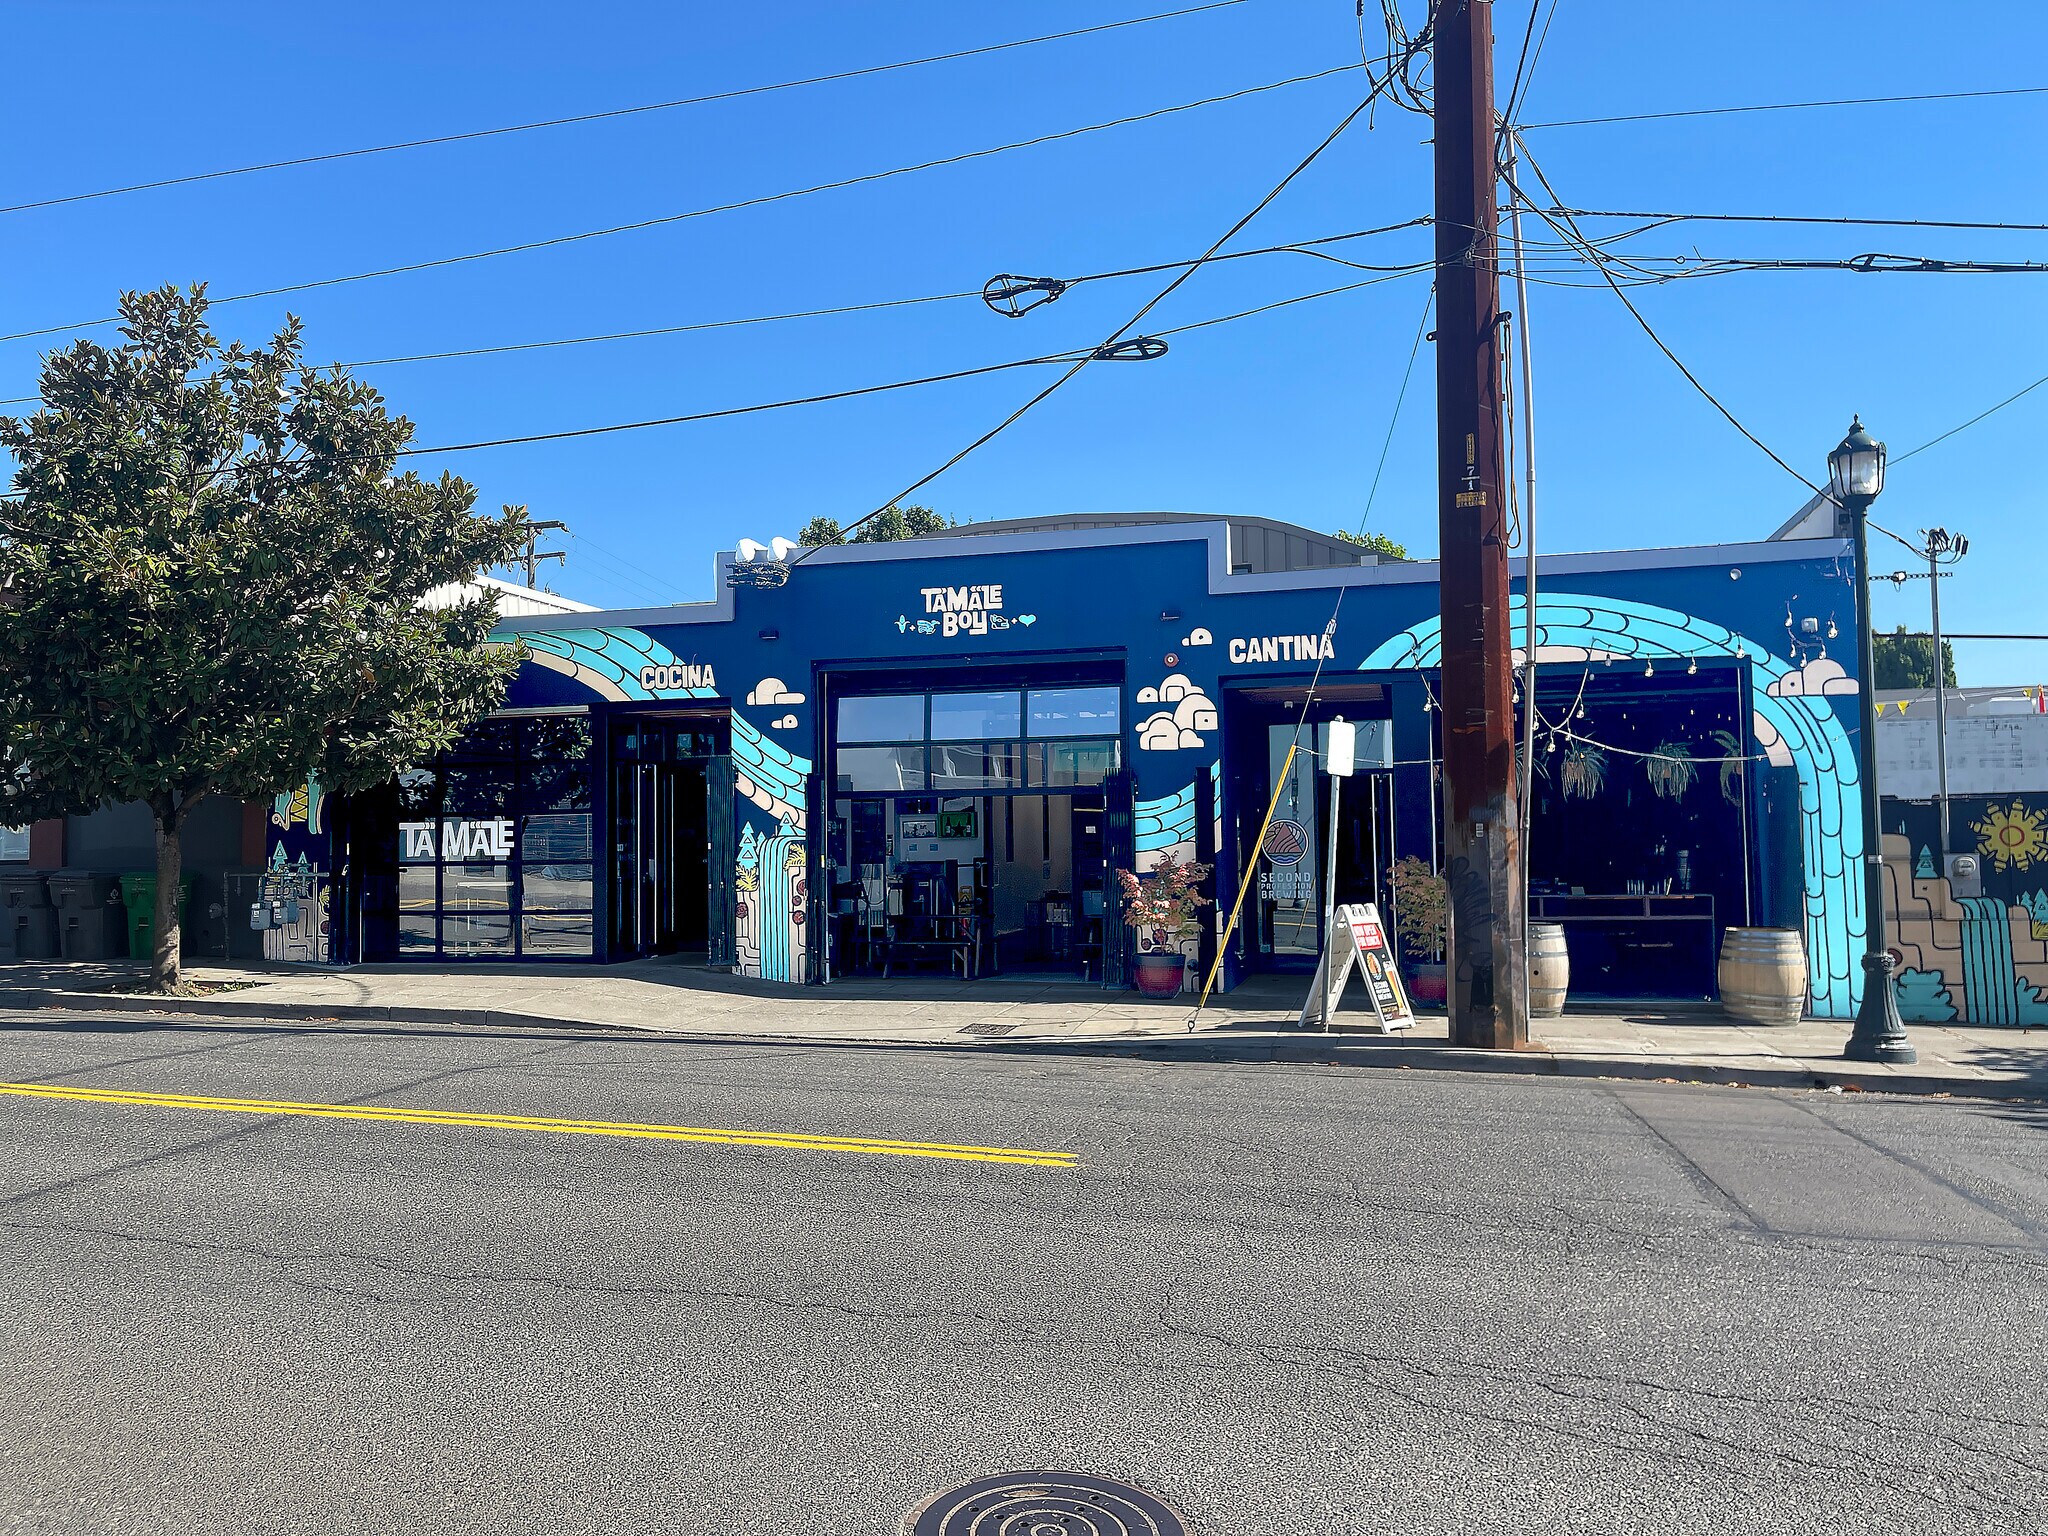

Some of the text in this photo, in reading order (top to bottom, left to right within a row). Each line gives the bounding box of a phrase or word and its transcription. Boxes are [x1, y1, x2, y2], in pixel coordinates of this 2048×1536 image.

[942, 610, 988, 637] BOY
[1229, 634, 1335, 664] CANTINA
[641, 664, 716, 690] COCINA
[1260, 872, 1311, 883] SECOND
[1260, 882, 1312, 890] PROFESSION
[1261, 890, 1312, 900] BREWING
